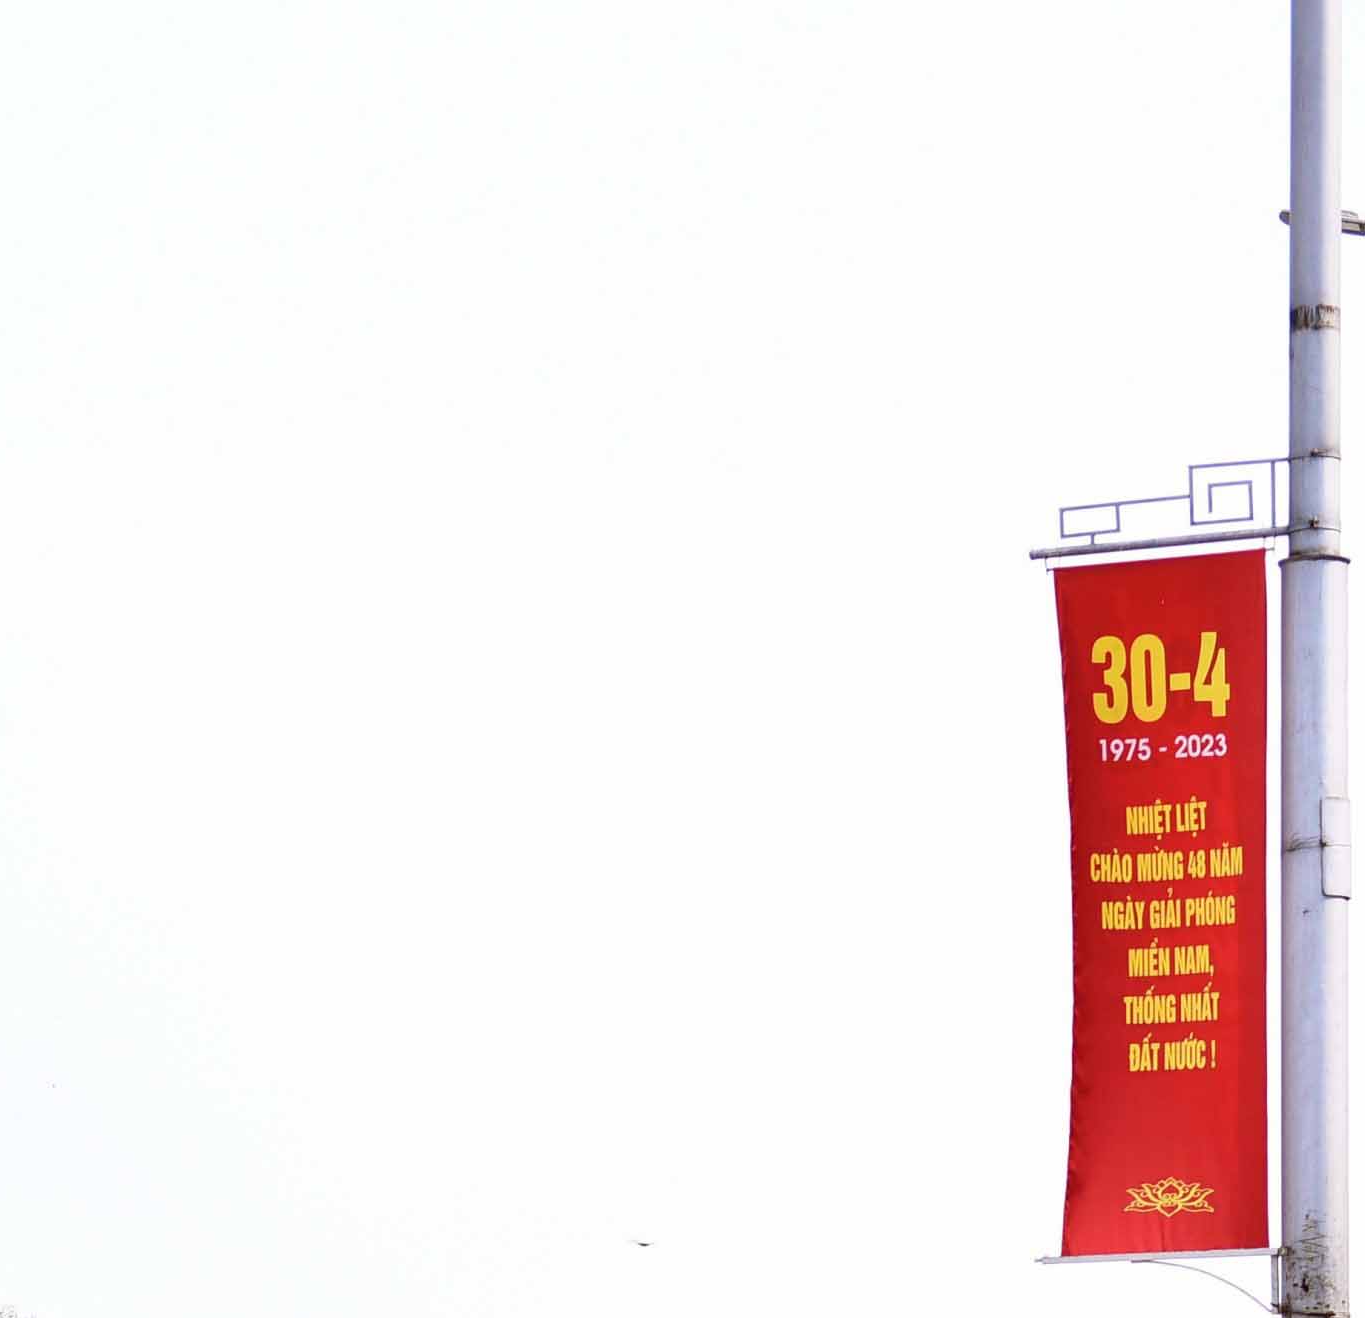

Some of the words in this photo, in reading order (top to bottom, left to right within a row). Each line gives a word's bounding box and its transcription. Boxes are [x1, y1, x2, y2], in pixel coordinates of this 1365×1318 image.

[1091, 631, 1231, 724] 30-4
[1099, 738, 1151, 762] 1975
[1174, 733, 1228, 758] 2023
[1126, 799, 1172, 840] NHIỆT
[1176, 795, 1207, 837] LIỆT
[1090, 847, 1132, 883] CHÀO
[1137, 846, 1184, 882] MỪNG
[1187, 849, 1206, 878] 48
[1210, 842, 1243, 877] NĂM
[1101, 895, 1145, 930] NGÀY
[1149, 887, 1181, 929] GIẢI
[1186, 891, 1235, 927] PHÓNG
[1128, 937, 1170, 977] MIỀN
[1174, 944, 1214, 977] NAM,
[1123, 985, 1176, 1025] THỐNG
[1180, 981, 1220, 1021] NHẤT
[1128, 1033, 1160, 1072] ĐẤT
[1164, 1032, 1206, 1070] NƯỚC
